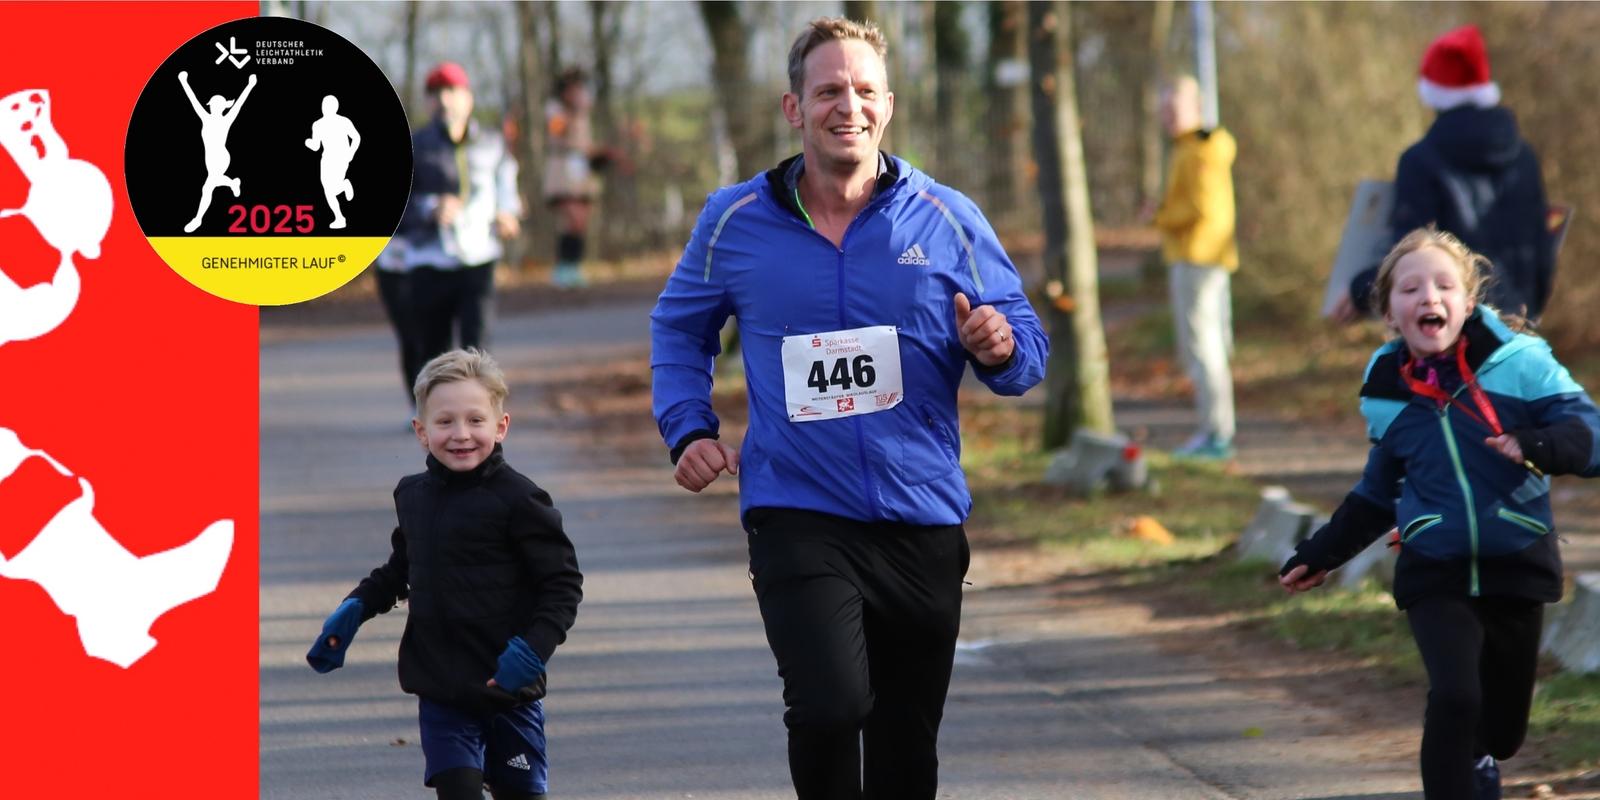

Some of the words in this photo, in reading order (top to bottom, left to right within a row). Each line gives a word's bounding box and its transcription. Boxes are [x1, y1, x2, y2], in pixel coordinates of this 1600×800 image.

[897, 256, 930, 266] adidas
[825, 337, 860, 348] Sparkasse
[826, 345, 862, 355] Darmstadt
[807, 354, 876, 393] 446
